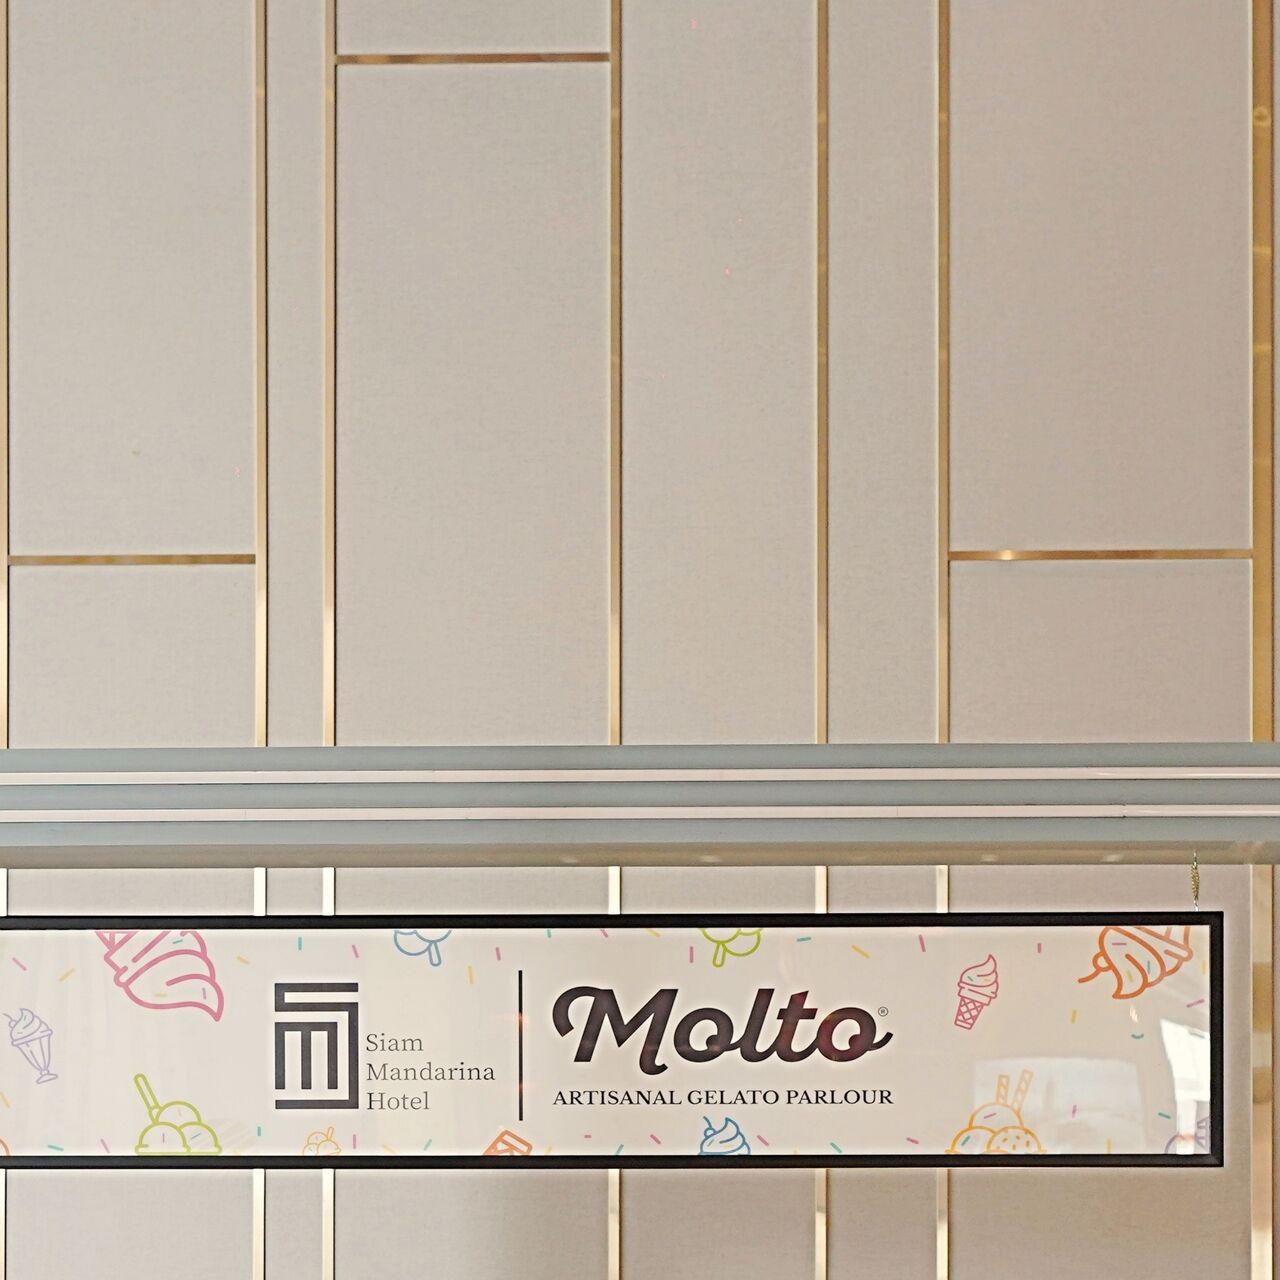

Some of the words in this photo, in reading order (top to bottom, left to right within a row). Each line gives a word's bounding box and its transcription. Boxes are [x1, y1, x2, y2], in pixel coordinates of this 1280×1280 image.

[366, 1033, 424, 1052] Siam
[366, 1061, 496, 1081] Mandarina
[366, 1091, 430, 1110] Hotel
[553, 1089, 682, 1106] ARTISANAL
[687, 1089, 780, 1106] GELATO
[786, 1089, 894, 1106] PARLOUR
